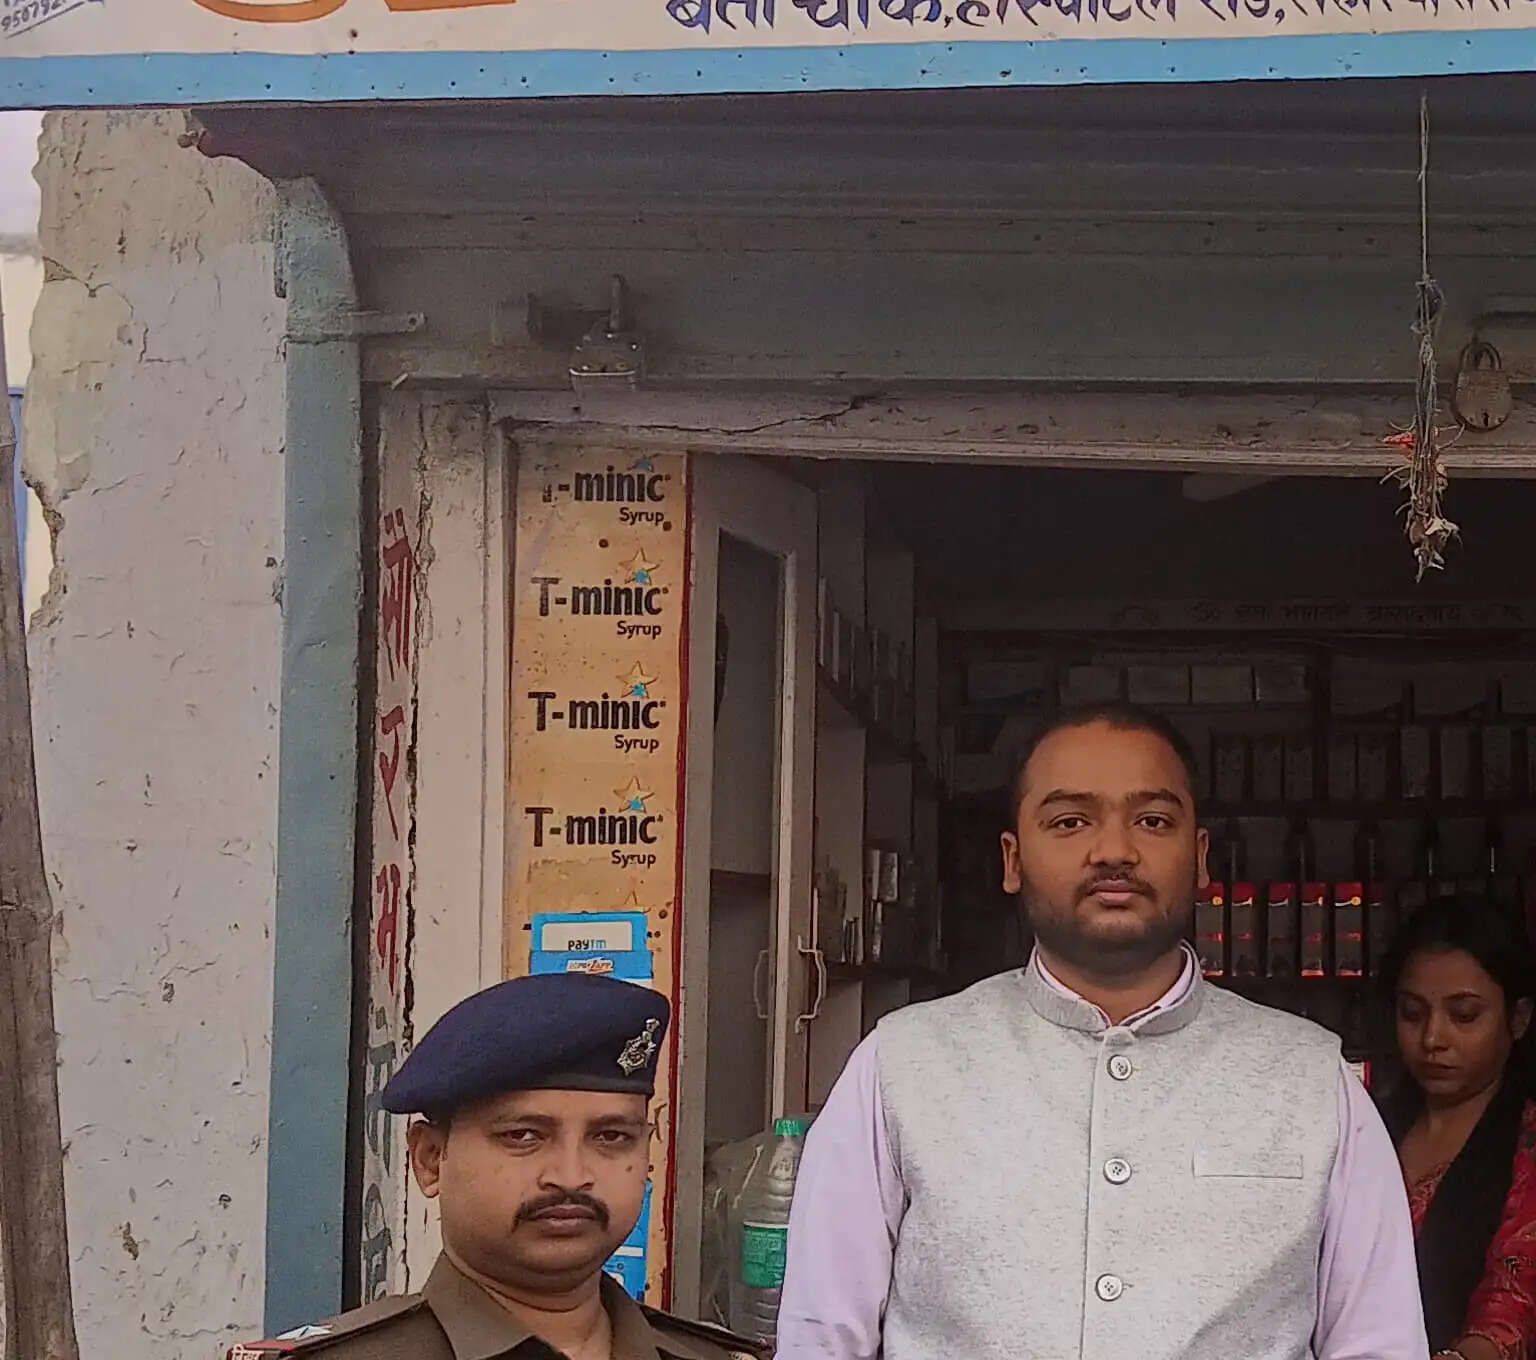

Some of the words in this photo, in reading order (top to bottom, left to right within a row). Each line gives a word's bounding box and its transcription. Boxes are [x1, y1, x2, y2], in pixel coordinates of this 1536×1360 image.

[538, 464, 668, 503] -minic
[619, 507, 665, 526] Syrup
[616, 620, 662, 640] Syrup
[614, 734, 660, 754] Syrup
[611, 849, 657, 869] Syrup
